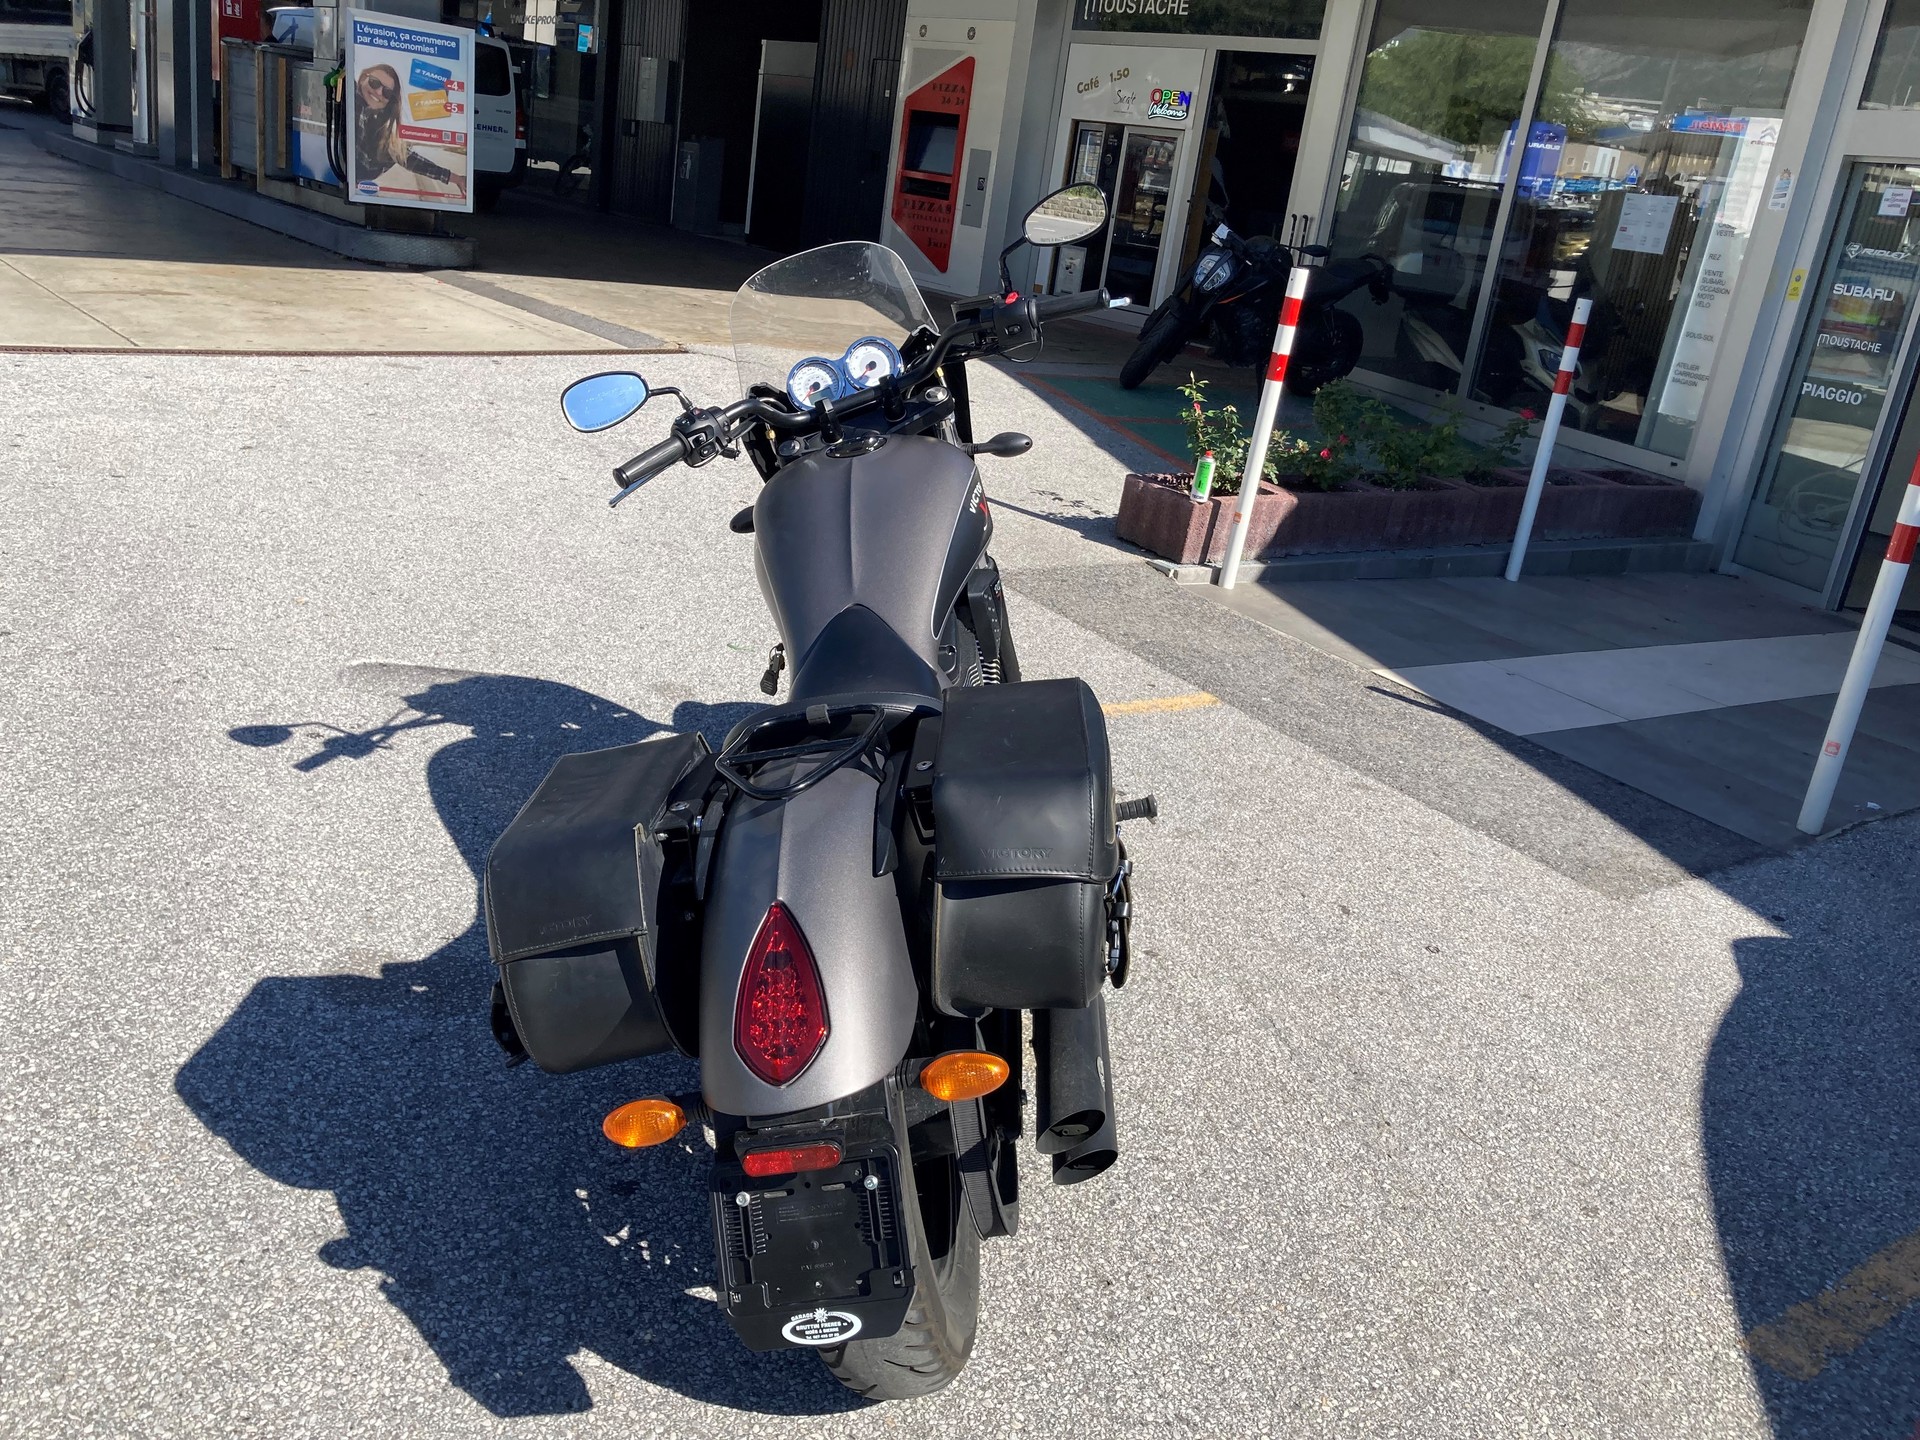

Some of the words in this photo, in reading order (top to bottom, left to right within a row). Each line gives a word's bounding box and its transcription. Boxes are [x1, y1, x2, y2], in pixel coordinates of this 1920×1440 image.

[356, 23, 398, 39] L'évasion,
[400, 32, 410, 41] ça
[412, 34, 457, 48] commence
[357, 35, 372, 45] par
[373, 37, 388, 47] des
[1077, 76, 1100, 94] Café
[1109, 68, 1130, 83] 1.50
[1150, 88, 1192, 107] OPEN
[1148, 101, 1188, 120] Welcome
[1716, 229, 1735, 238] VESTE
[1709, 253, 1722, 261] REZ
[1861, 247, 1911, 260] RIDLEY
[1704, 269, 1724, 278] VENTE
[1702, 277, 1726, 286] SUBARU
[1700, 285, 1730, 295] OCCASION
[1833, 283, 1895, 302] SUBARU
[1697, 293, 1715, 301] MOTO
[1817, 333, 1882, 353] MOUSTACHE
[1676, 361, 1700, 372] ATELIER
[1672, 376, 1698, 387] MAGASIN
[1801, 382, 1862, 405] PIAGGIO
[977, 847, 1054, 860] VICTORY
[791, 1312, 813, 1322] GARAGE
